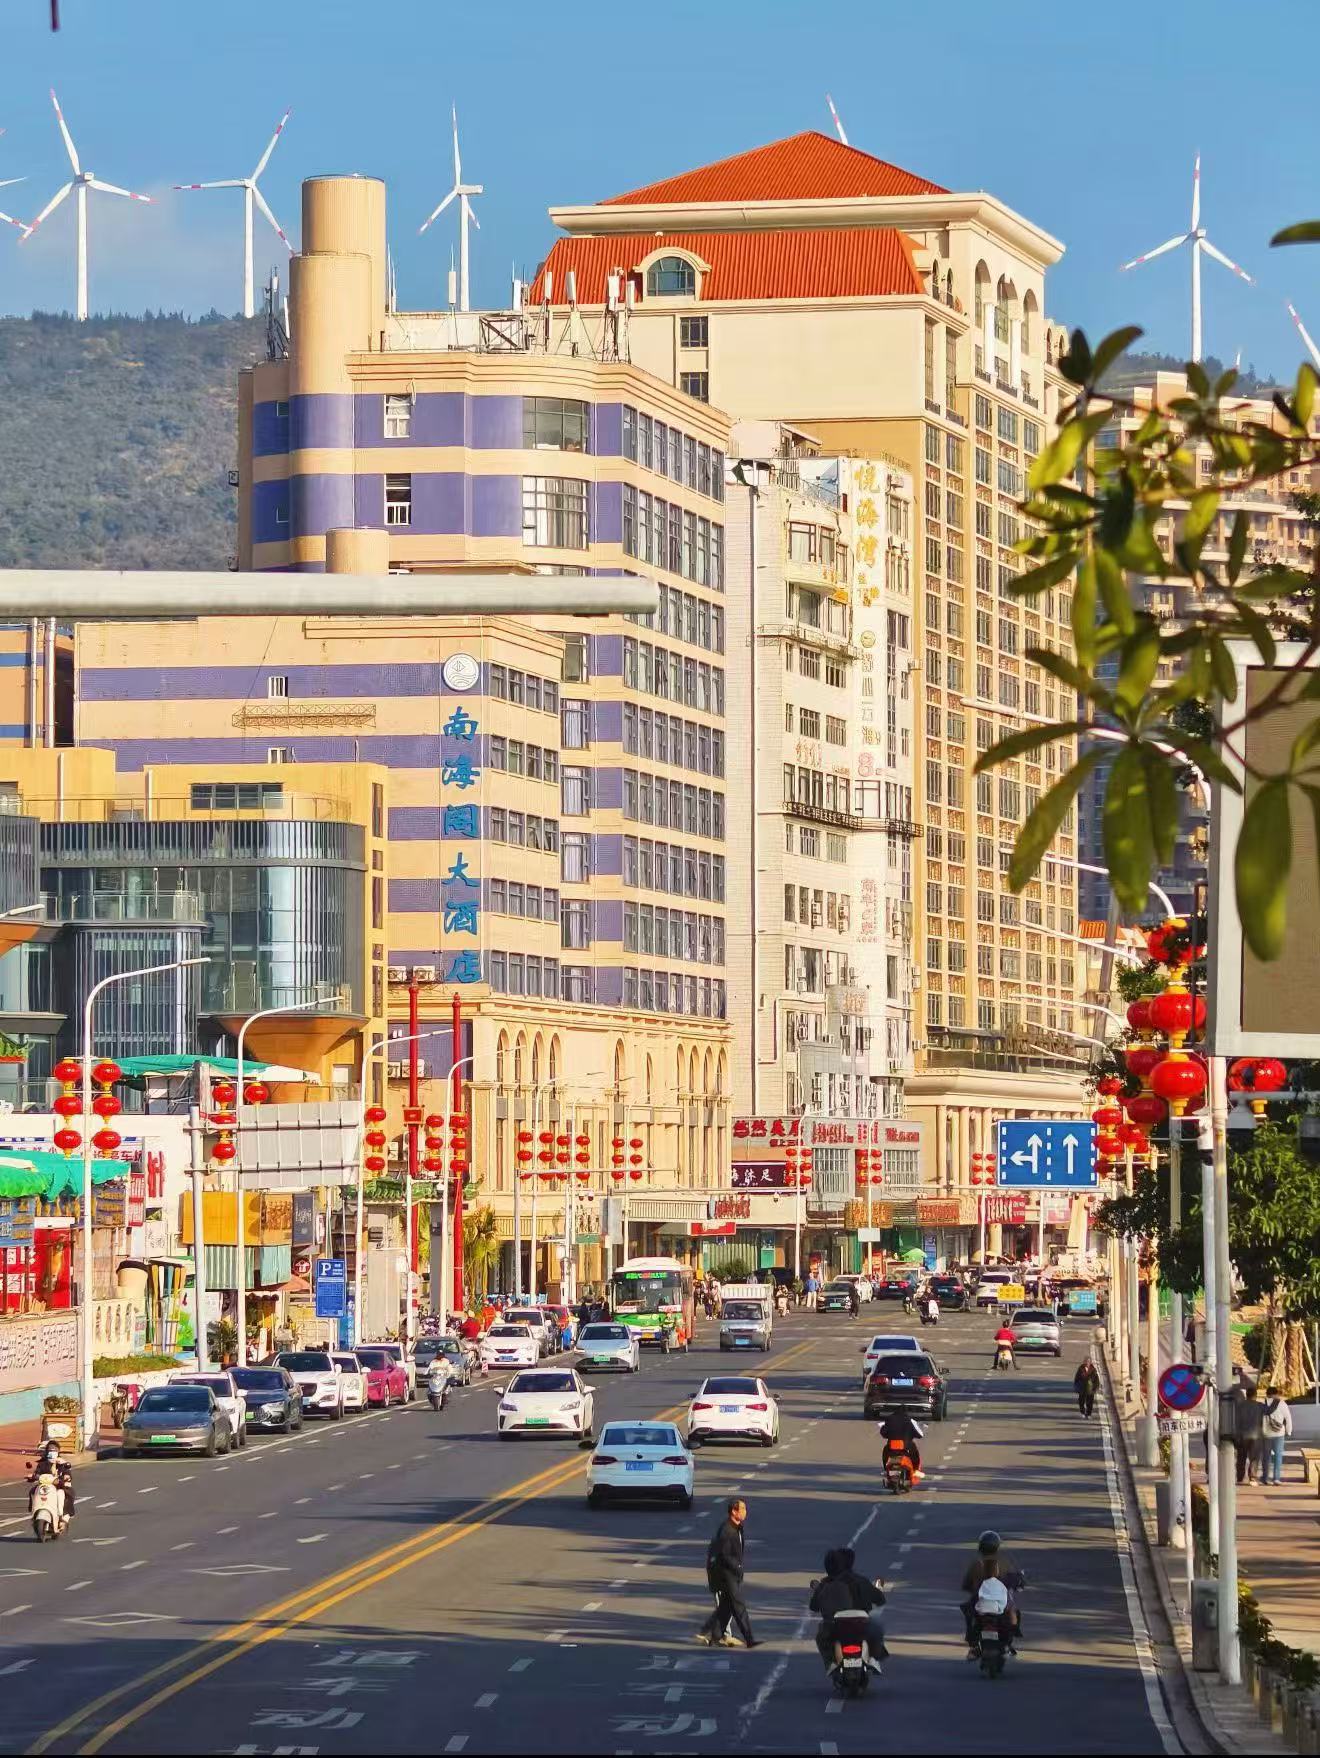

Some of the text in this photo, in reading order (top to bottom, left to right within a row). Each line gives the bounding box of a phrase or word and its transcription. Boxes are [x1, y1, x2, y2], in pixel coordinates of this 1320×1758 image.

[441, 706, 482, 983] 南海阁大酒店
[321, 1263, 331, 1276] P
